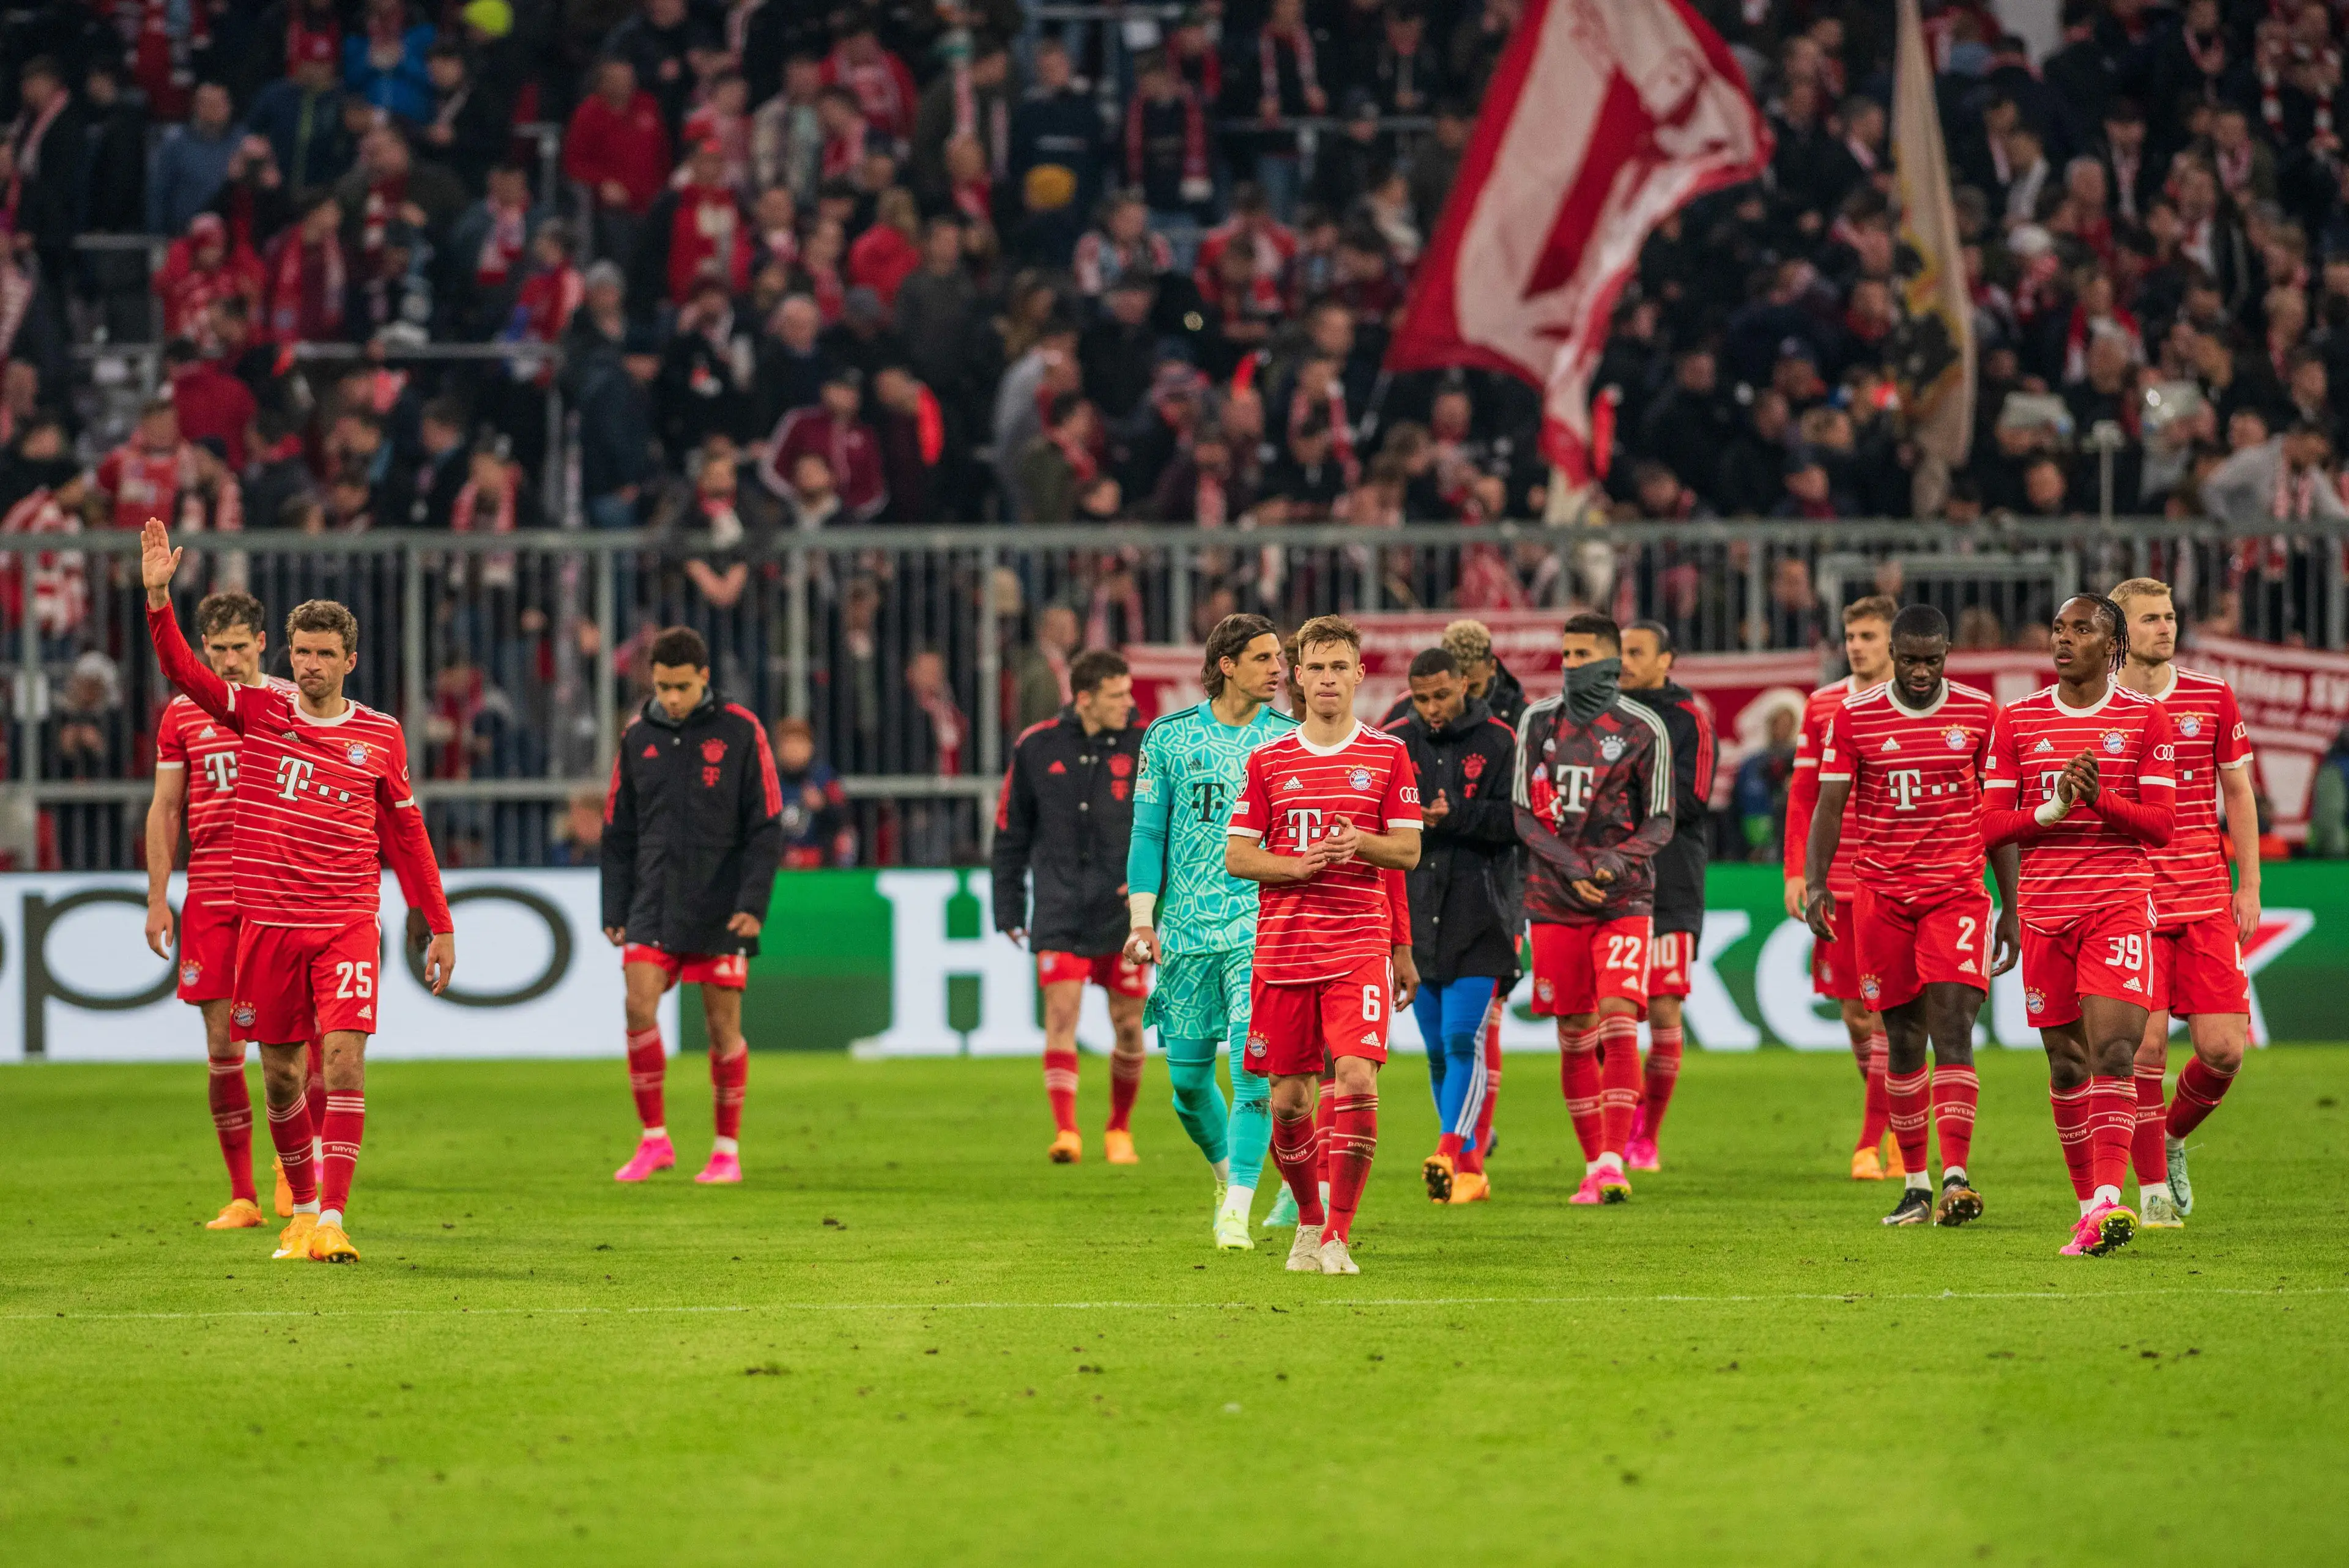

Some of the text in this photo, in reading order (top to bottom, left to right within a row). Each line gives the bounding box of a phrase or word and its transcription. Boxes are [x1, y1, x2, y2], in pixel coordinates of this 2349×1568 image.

[1193, 783, 1224, 822] T
[1652, 934, 1678, 967] 10
[1956, 917, 1975, 950] 2
[1606, 934, 1641, 971] 22
[2105, 934, 2142, 971] 39
[337, 961, 372, 999] 25
[2123, 983, 2143, 993] adidas
[1362, 984, 1381, 1021] 6
[1360, 1038, 1381, 1047] adidas
